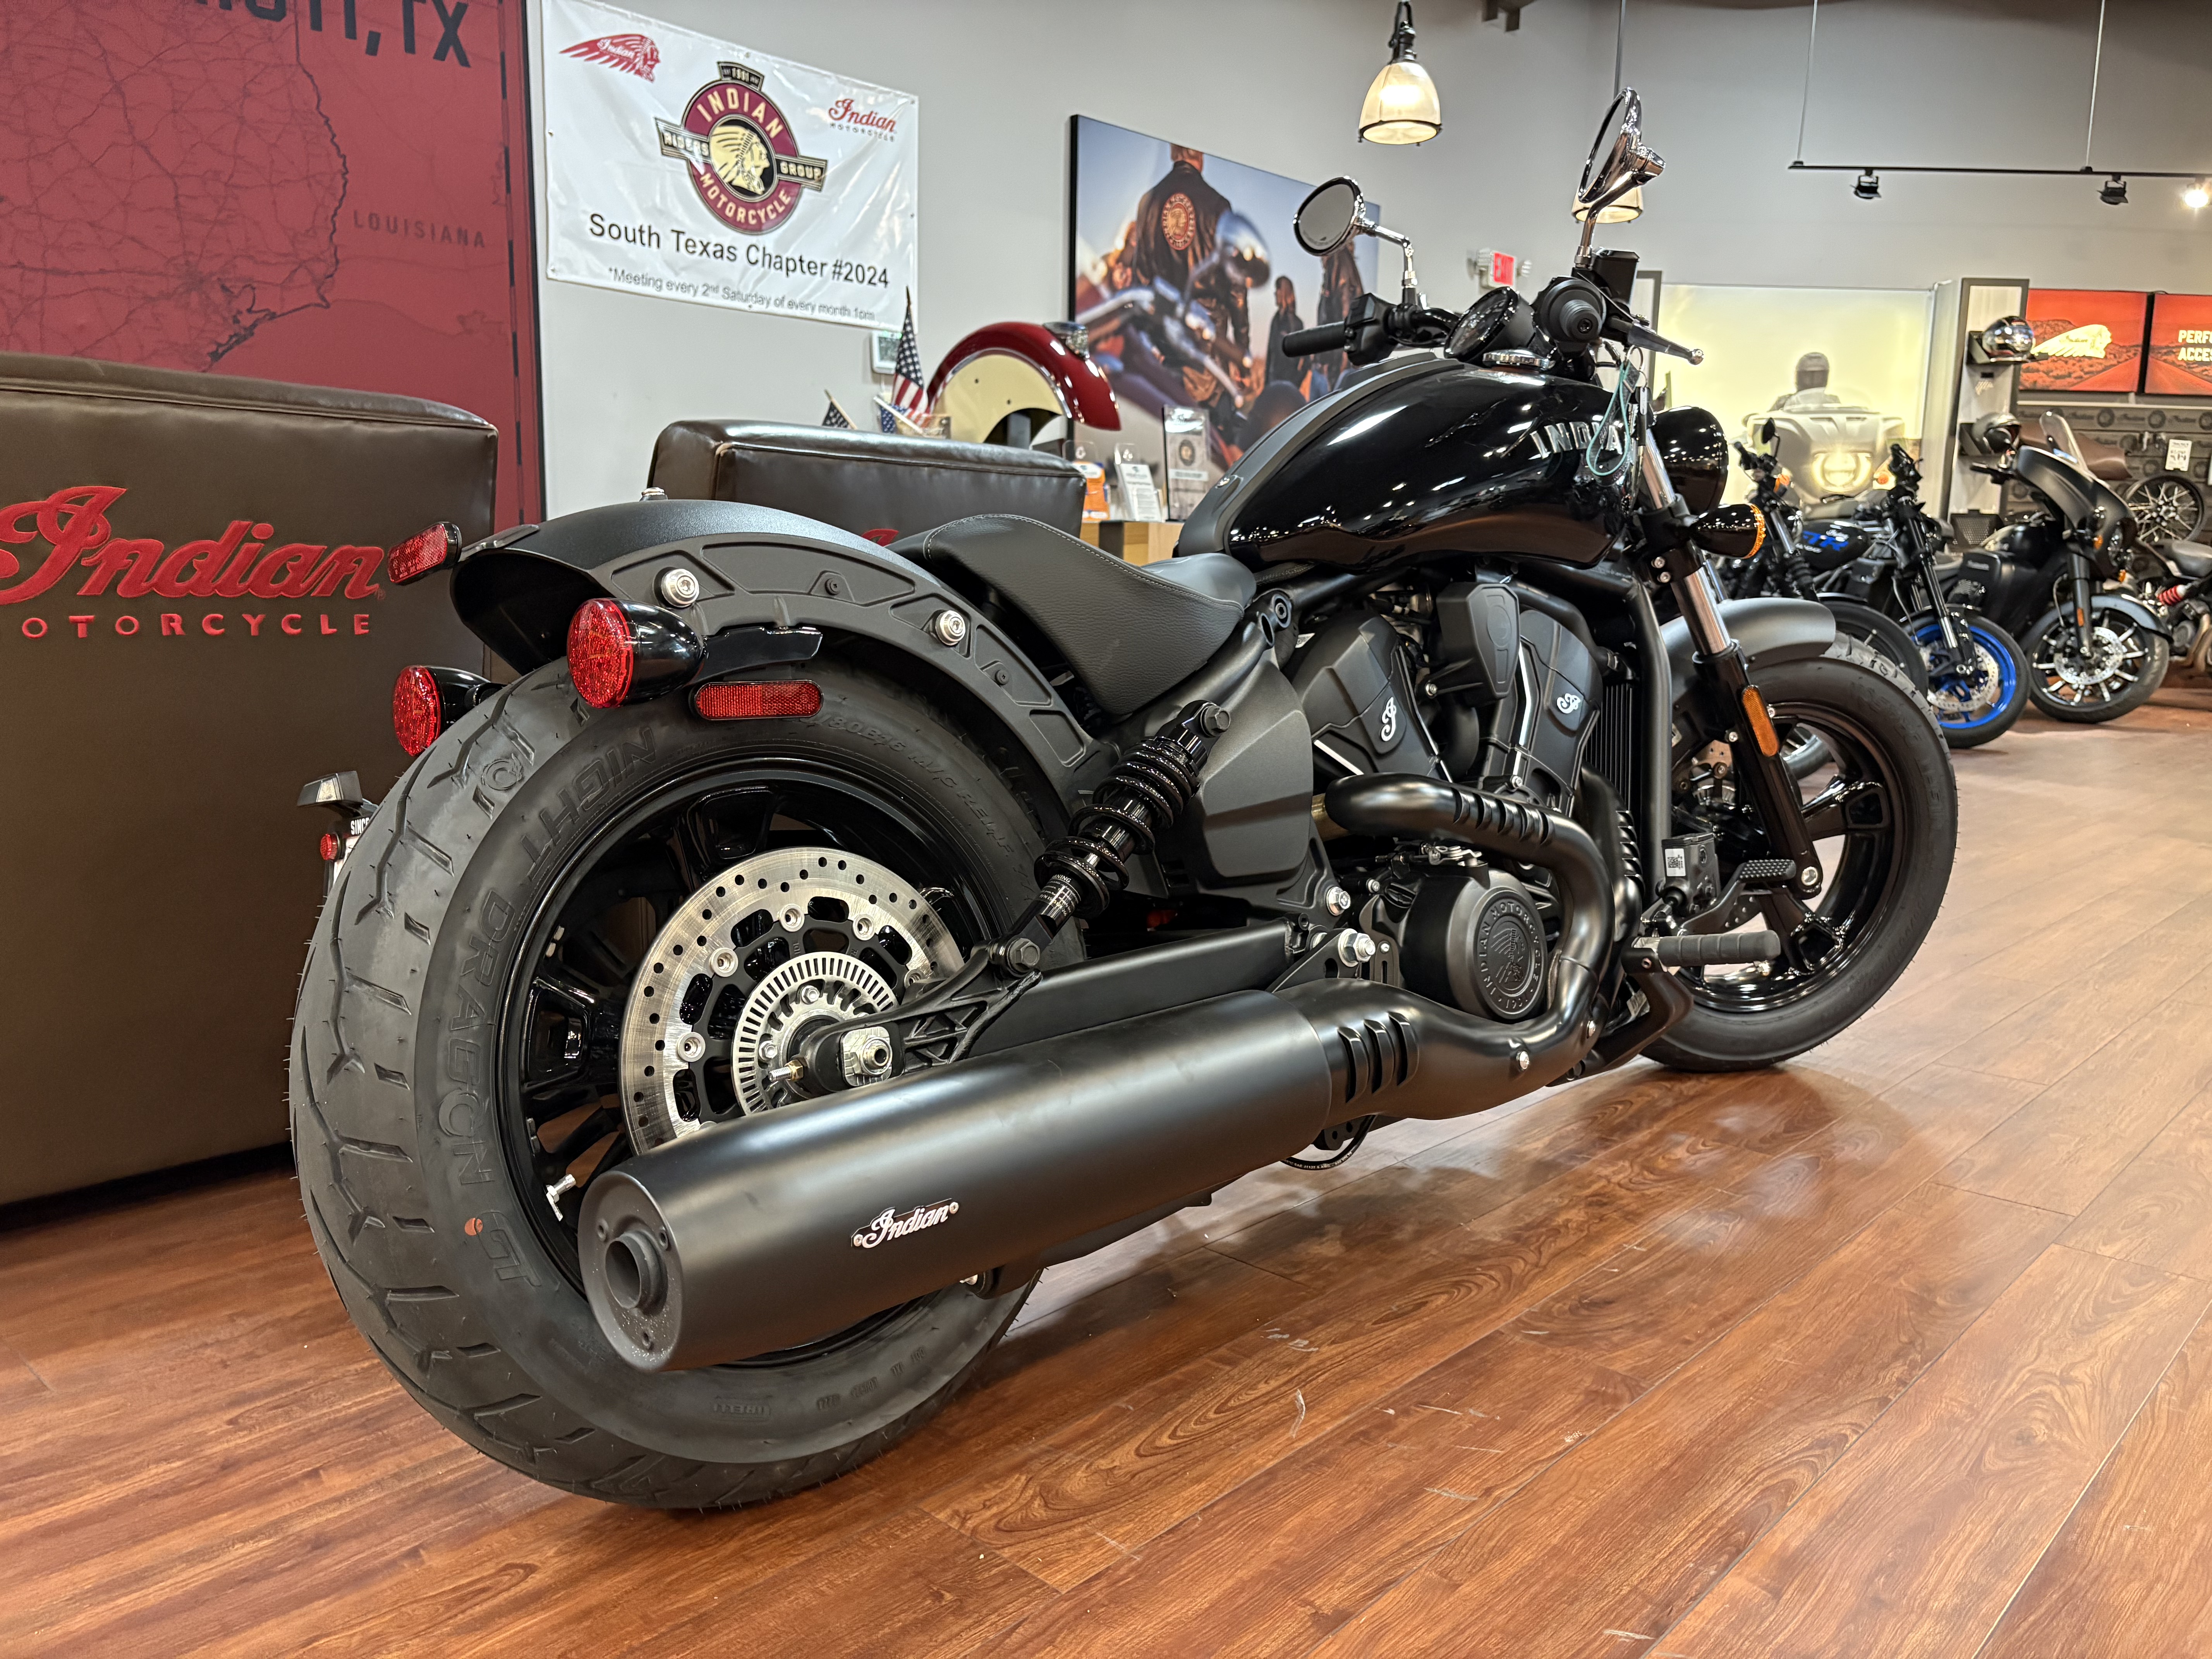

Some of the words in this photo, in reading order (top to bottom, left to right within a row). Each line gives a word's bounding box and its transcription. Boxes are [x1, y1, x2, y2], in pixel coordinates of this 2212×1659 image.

[697, 88, 783, 138] INDIAN
[828, 99, 896, 132] Indian
[664, 132, 709, 156] RIDERS
[780, 161, 821, 181] GROUP
[700, 173, 791, 225] MOTORCYCLE
[353, 211, 486, 249] LOUISIANA
[589, 213, 661, 249] South
[671, 229, 737, 262] Texas
[746, 244, 828, 278] Chapter
[831, 259, 890, 289] #2024
[666, 280, 699, 297] every
[721, 286, 771, 307] Saturday
[774, 295, 785, 307] of
[787, 300, 816, 314] every
[818, 304, 852, 317] month
[2178, 330, 2212, 344] PERF
[2178, 347, 2212, 362] ACCE
[1530, 421, 1629, 460] INDIA
[0, 486, 384, 605] Indian
[520, 726, 657, 882] NIGHT
[1051, 874, 1072, 883] RNING
[438, 890, 515, 1186] DRAGON
[862, 1205, 949, 1249] Indian
